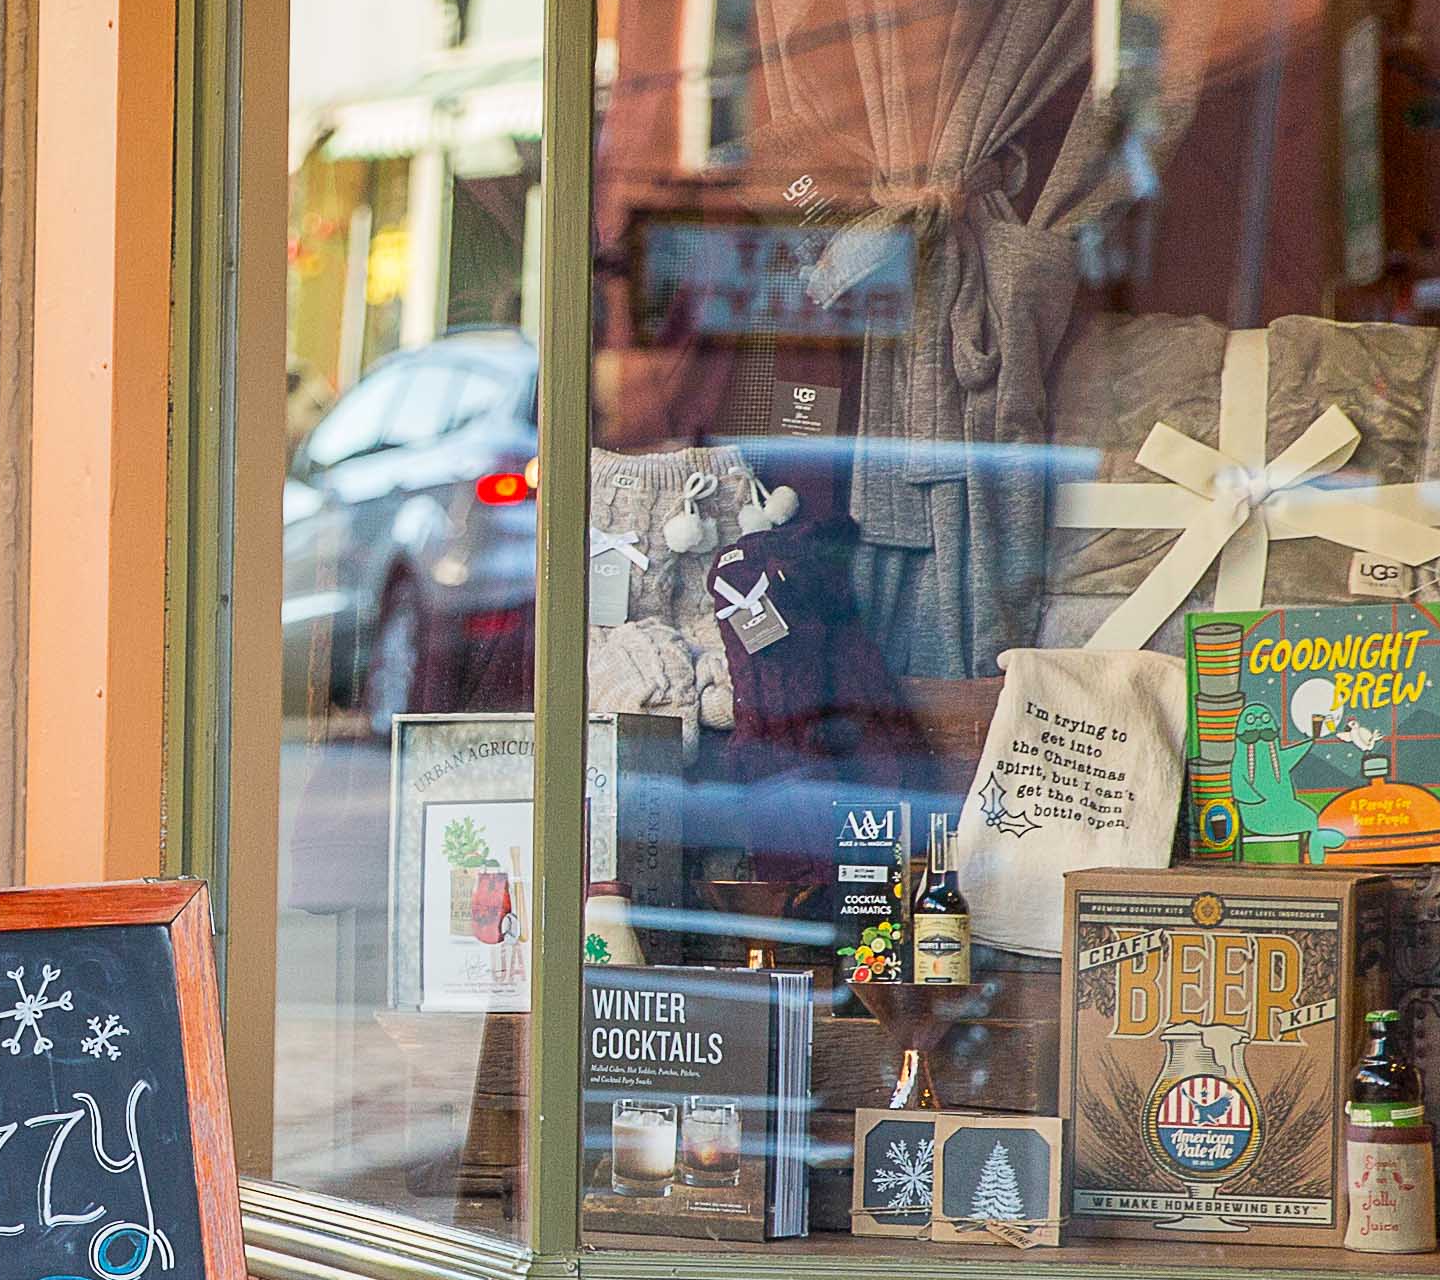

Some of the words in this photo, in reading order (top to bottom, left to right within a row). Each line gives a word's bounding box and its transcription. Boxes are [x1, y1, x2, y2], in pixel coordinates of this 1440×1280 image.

[782, 173, 814, 202] UGG
[793, 387, 816, 403] UGG
[1359, 562, 1399, 580] UGG
[1248, 629, 1430, 676] GOODNIGHT
[1330, 671, 1428, 711] BREW
[1025, 701, 1049, 722] I'm
[1054, 713, 1108, 741] trying
[1111, 727, 1128, 743] to
[1040, 731, 1066, 747] get
[1070, 739, 1103, 759] into
[413, 750, 464, 793] URBAN
[1012, 739, 1039, 757] the
[1043, 749, 1126, 782] Christmas
[996, 759, 1047, 782] spirit,
[1051, 771, 1079, 788] but
[1084, 780, 1091, 791] I
[1095, 786, 1135, 802] can't
[1016, 783, 1042, 799] get
[1047, 787, 1074, 804] the
[1079, 796, 1123, 814] damn
[836, 810, 897, 840] A&M
[1034, 803, 1082, 821] bottle
[1087, 815, 1131, 831] open.
[840, 904, 892, 915] AROMATICS
[844, 894, 888, 905] COCKTAIL
[1091, 905, 1128, 915] PREMIUM
[1129, 906, 1163, 915] QUALITY
[1165, 907, 1185, 915] KITS
[1230, 909, 1254, 918] CRAFT
[1256, 909, 1277, 918] LEVEL
[1278, 910, 1325, 919] INGREDIENTS
[1088, 933, 1155, 966] CRAFT
[1108, 927, 1308, 1046] BEER
[592, 988, 686, 1024] WINTER
[1289, 1002, 1327, 1026] KIT
[591, 1026, 723, 1065] COCKTAILS
[1170, 1128, 1235, 1146] American
[1176, 1142, 1209, 1159] Pale
[1208, 1143, 1233, 1161] Ale
[1092, 1196, 1113, 1208] WE
[1120, 1197, 1159, 1209] MAKE
[1165, 1199, 1268, 1215] HOMEBREWING
[1362, 1190, 1398, 1213] Jolly
[1360, 1215, 1400, 1236] Juice
